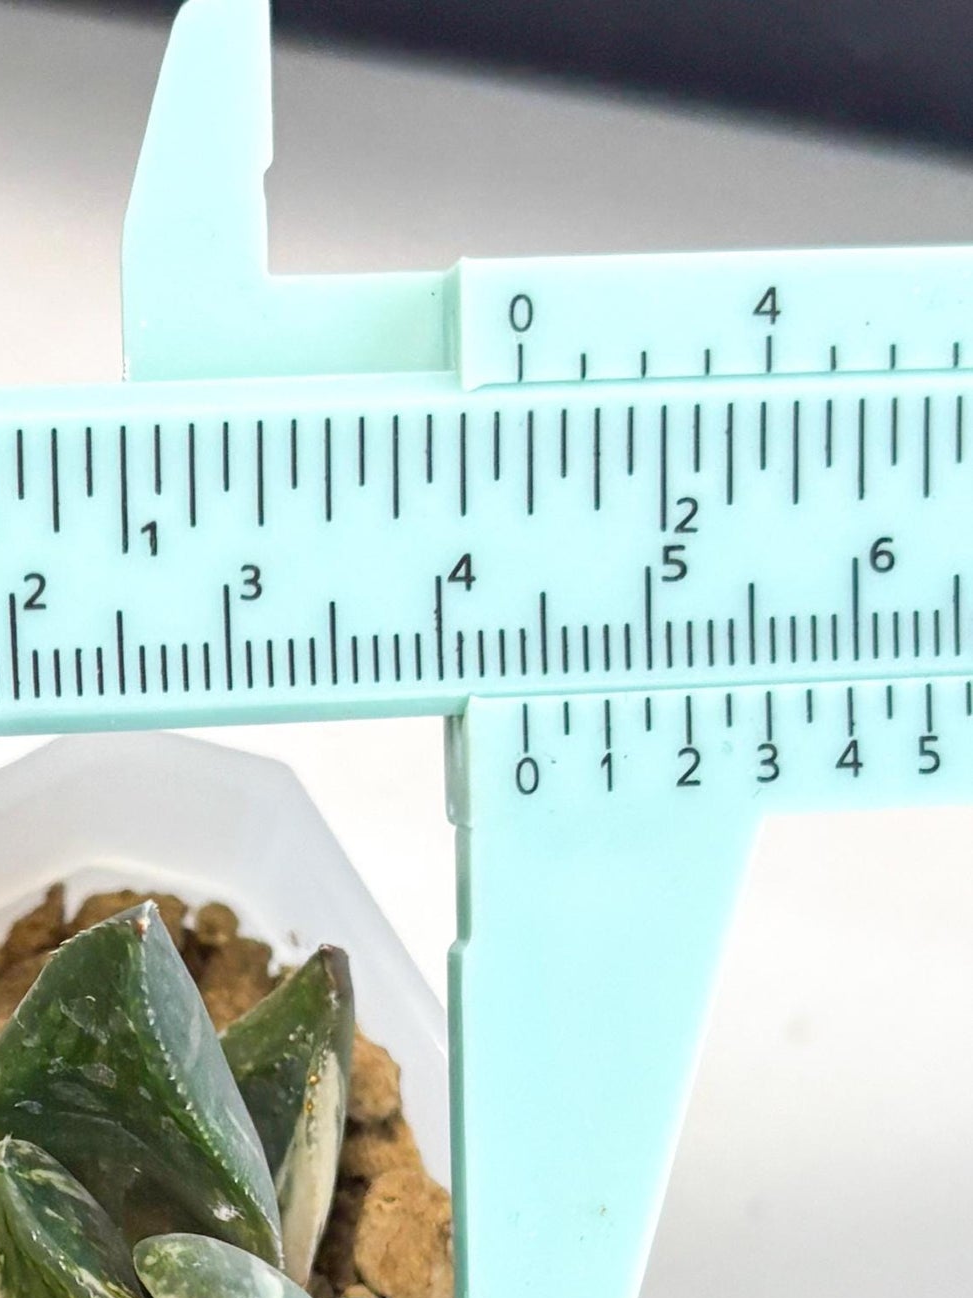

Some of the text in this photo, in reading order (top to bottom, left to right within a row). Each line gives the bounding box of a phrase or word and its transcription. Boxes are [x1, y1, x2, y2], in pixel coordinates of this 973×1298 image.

[508, 285, 782, 333] 0 4
[140, 520, 159, 558] 1
[673, 496, 699, 534] 2
[22, 571, 47, 612] 2
[239, 563, 263, 602] 3
[446, 552, 477, 593] 4
[661, 543, 689, 583] 5
[868, 536, 896, 574] 6
[515, 735, 941, 796] 0 1 2 3 4 5
